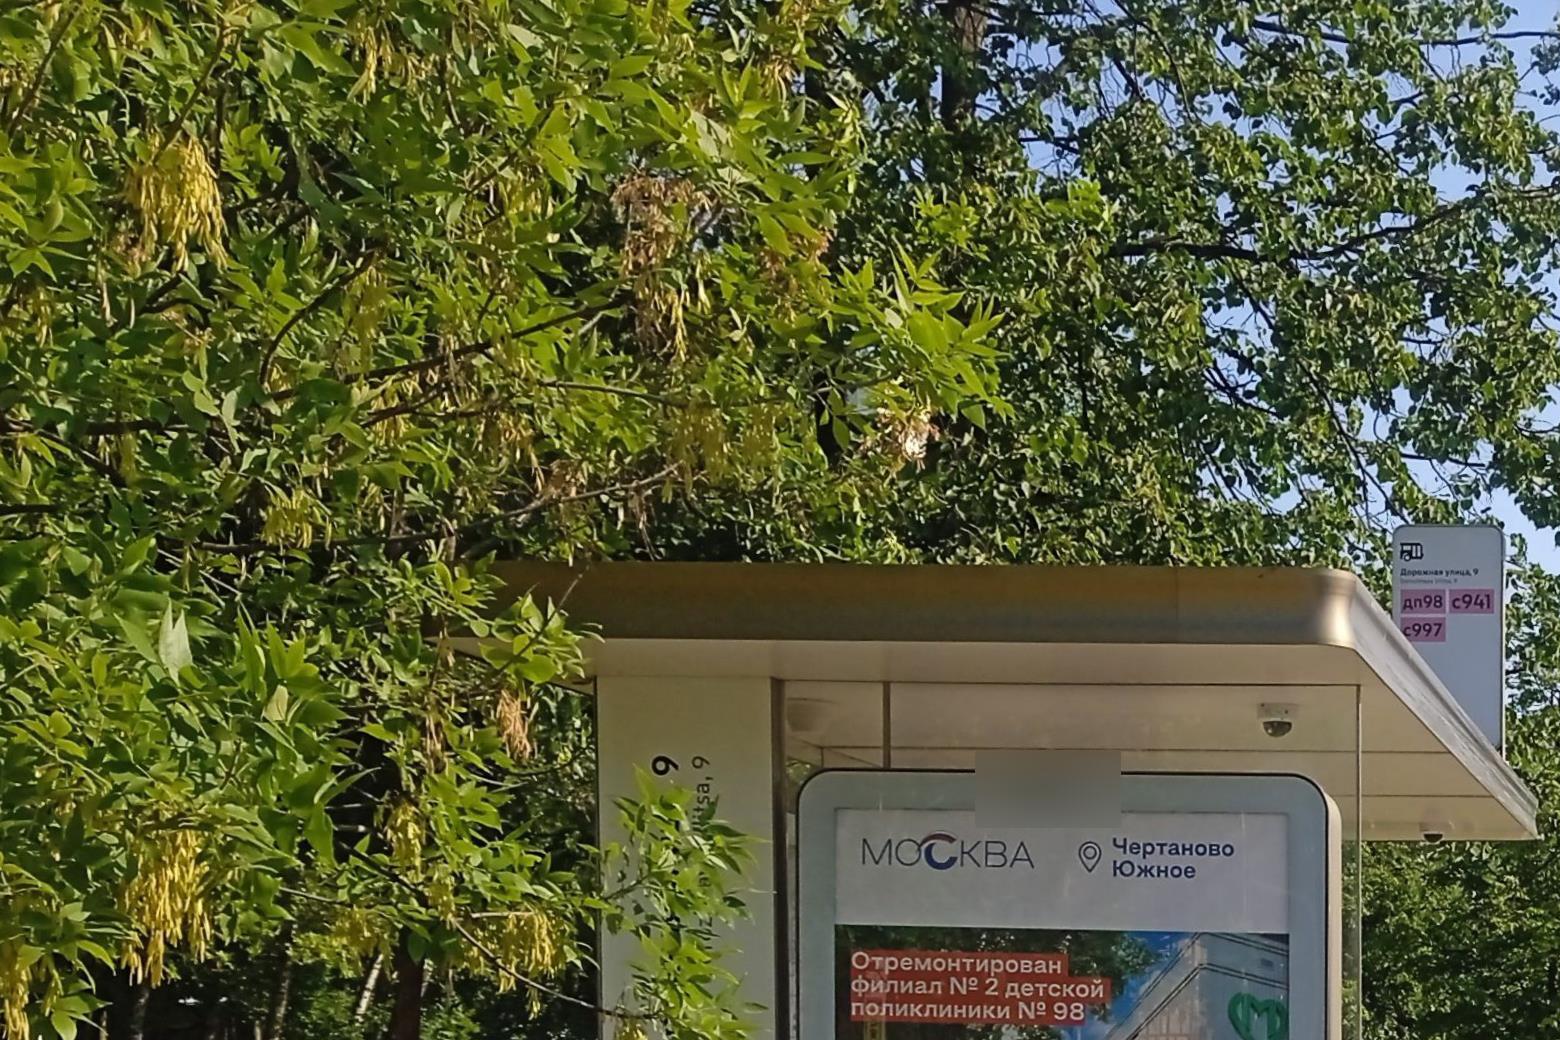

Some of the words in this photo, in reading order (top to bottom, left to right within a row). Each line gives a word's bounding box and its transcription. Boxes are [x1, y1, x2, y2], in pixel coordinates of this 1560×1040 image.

[1400, 568, 1443, 577] Дорожная
[1445, 569, 1472, 578] улица,
[1473, 568, 1479, 576] 9
[1403, 595, 1442, 611] дп98
[1452, 594, 1491, 609] с941
[1403, 623, 1442, 637] с997
[651, 755, 679, 776] 9
[691, 755, 711, 769] 9
[861, 829, 1035, 871] МОСКВА
[1112, 837, 1235, 859] Чертаново
[1112, 860, 1197, 879] Южное
[850, 951, 1062, 975] Отремонтирован
[850, 975, 943, 998] филиал
[949, 976, 979, 996] №
[984, 979, 999, 997] 2
[1004, 979, 1105, 1000] детской
[850, 1001, 1011, 1020] поликлиники
[1017, 1001, 1047, 1020] №
[1053, 1002, 1086, 1021] 98
